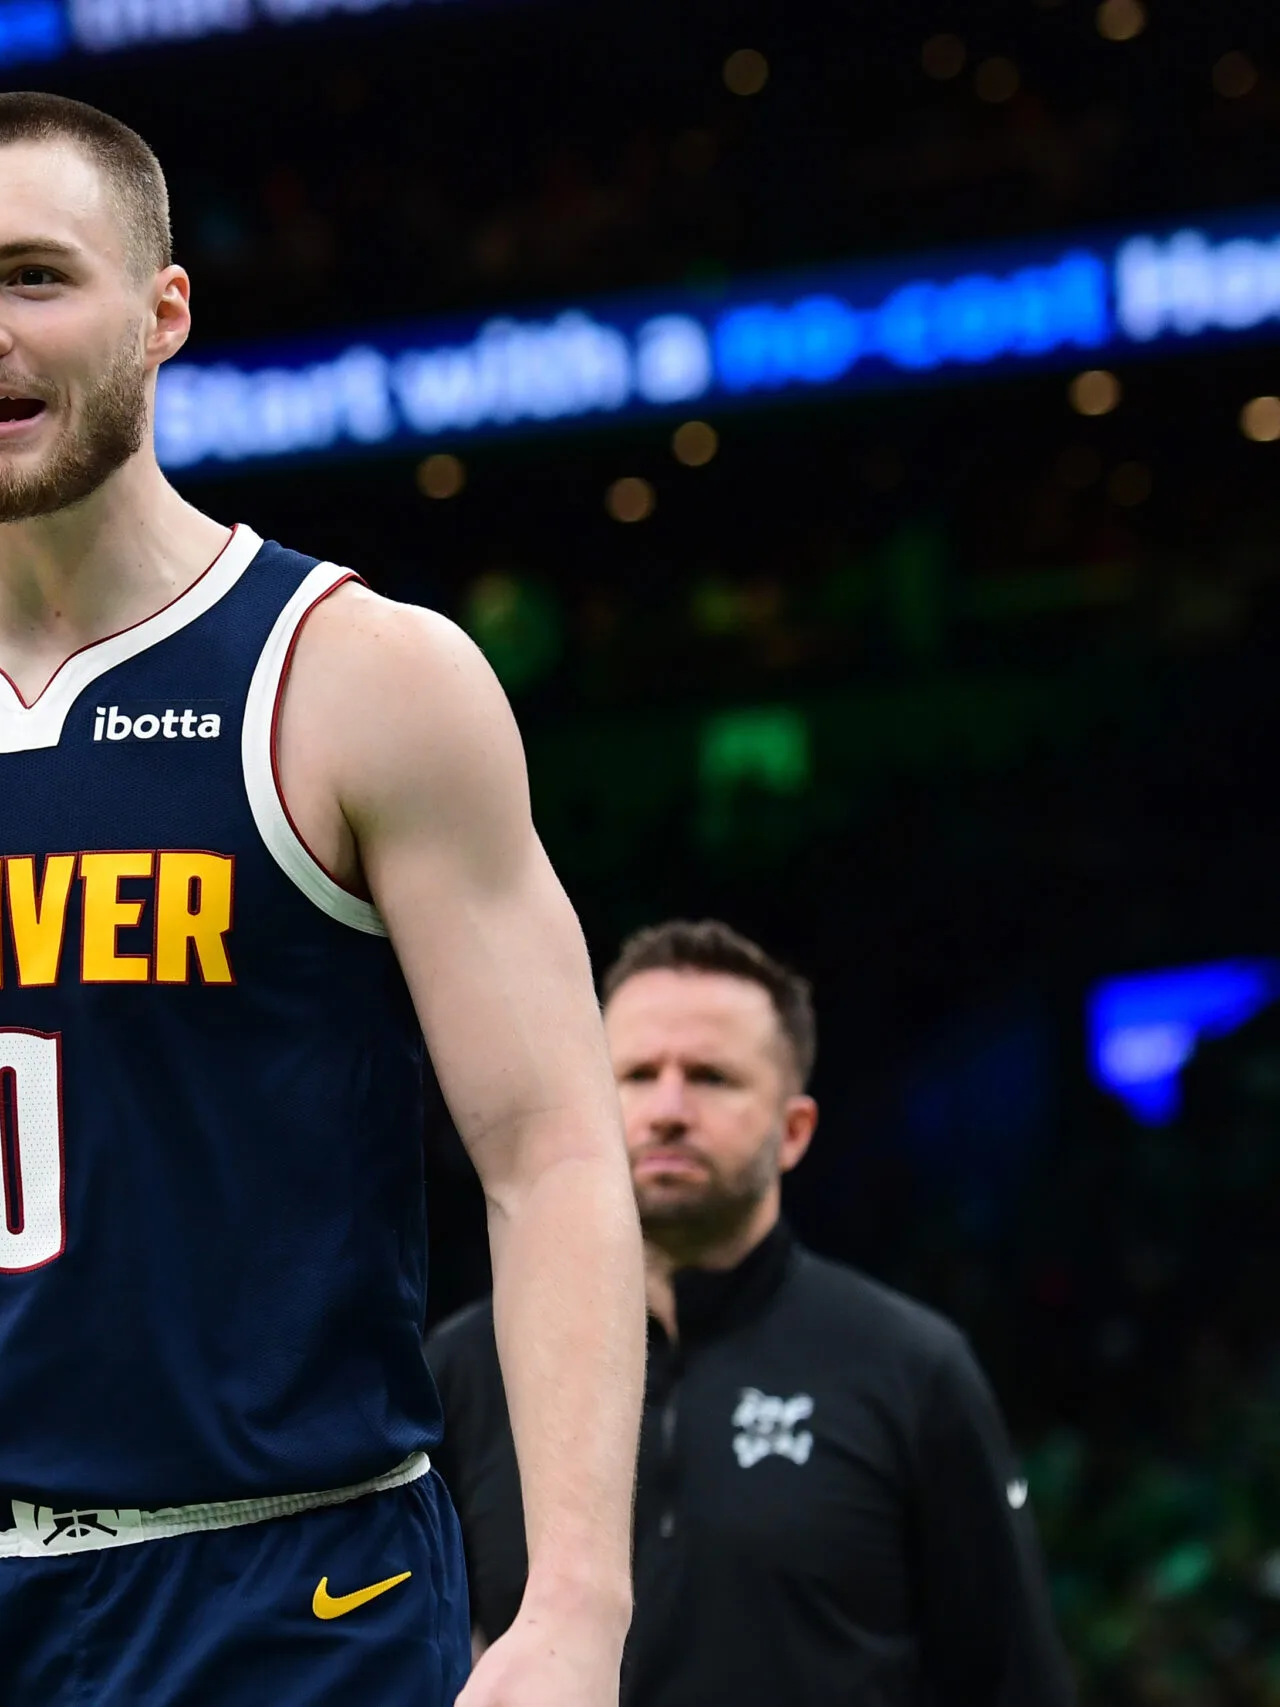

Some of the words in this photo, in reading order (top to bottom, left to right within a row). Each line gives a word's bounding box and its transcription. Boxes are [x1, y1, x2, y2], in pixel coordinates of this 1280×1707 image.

[395, 310, 630, 434] with
[637, 314, 712, 403] a
[716, 250, 1108, 392] no-cost
[93, 705, 221, 741] ibotta
